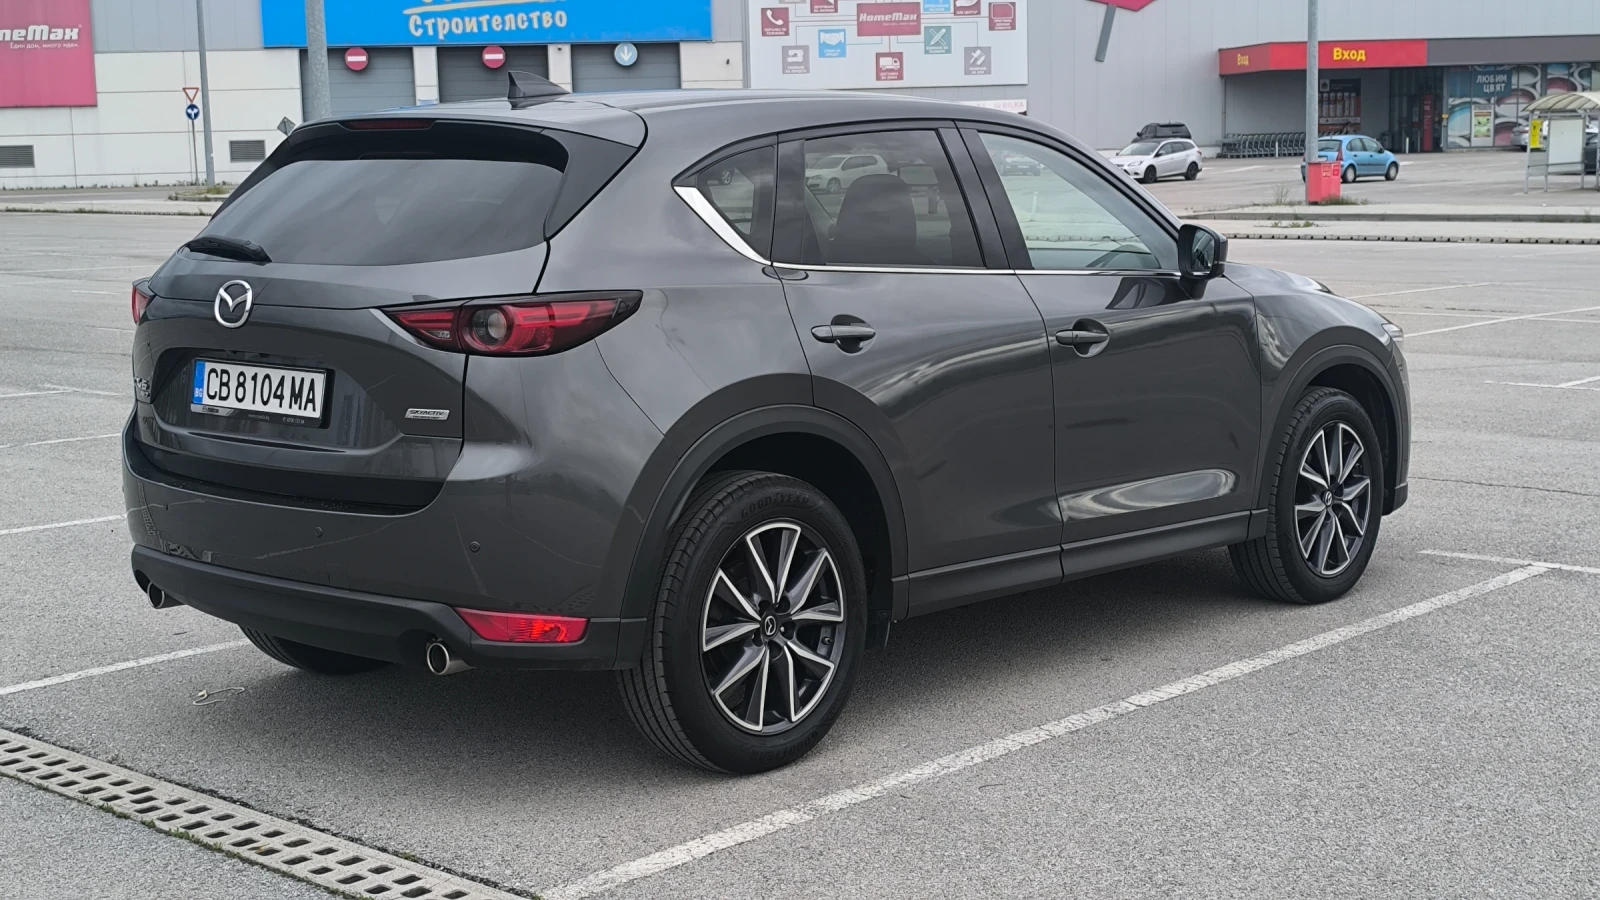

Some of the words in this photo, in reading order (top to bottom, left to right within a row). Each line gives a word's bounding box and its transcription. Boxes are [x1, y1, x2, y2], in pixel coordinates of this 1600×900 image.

[860, 12, 918, 22] HomeMax
[408, 10, 568, 41] Строителство
[1237, 53, 1249, 66] Вход
[1333, 47, 1366, 62] Вход
[1476, 74, 1508, 83] ЛЮБИМ
[1483, 83, 1506, 93] ЦВЯТ
[206, 367, 231, 401] CB
[235, 371, 285, 408] 8104
[289, 376, 316, 412] MA
